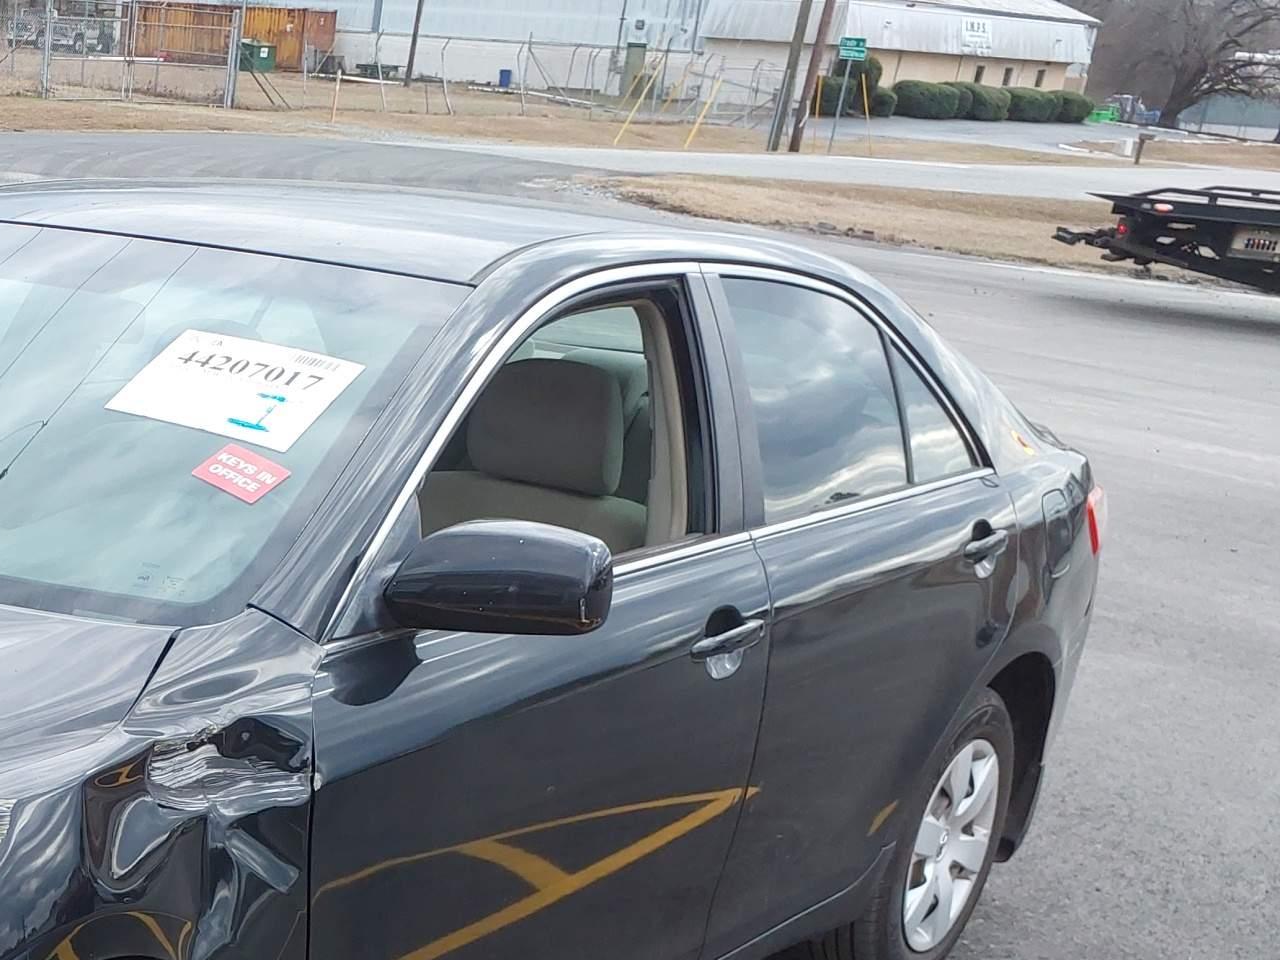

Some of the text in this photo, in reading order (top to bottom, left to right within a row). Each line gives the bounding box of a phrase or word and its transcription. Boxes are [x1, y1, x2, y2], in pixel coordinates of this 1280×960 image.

[177, 350, 325, 391] 44207017
[208, 463, 261, 493] OFFICE
[217, 452, 278, 485] KEYS IN
